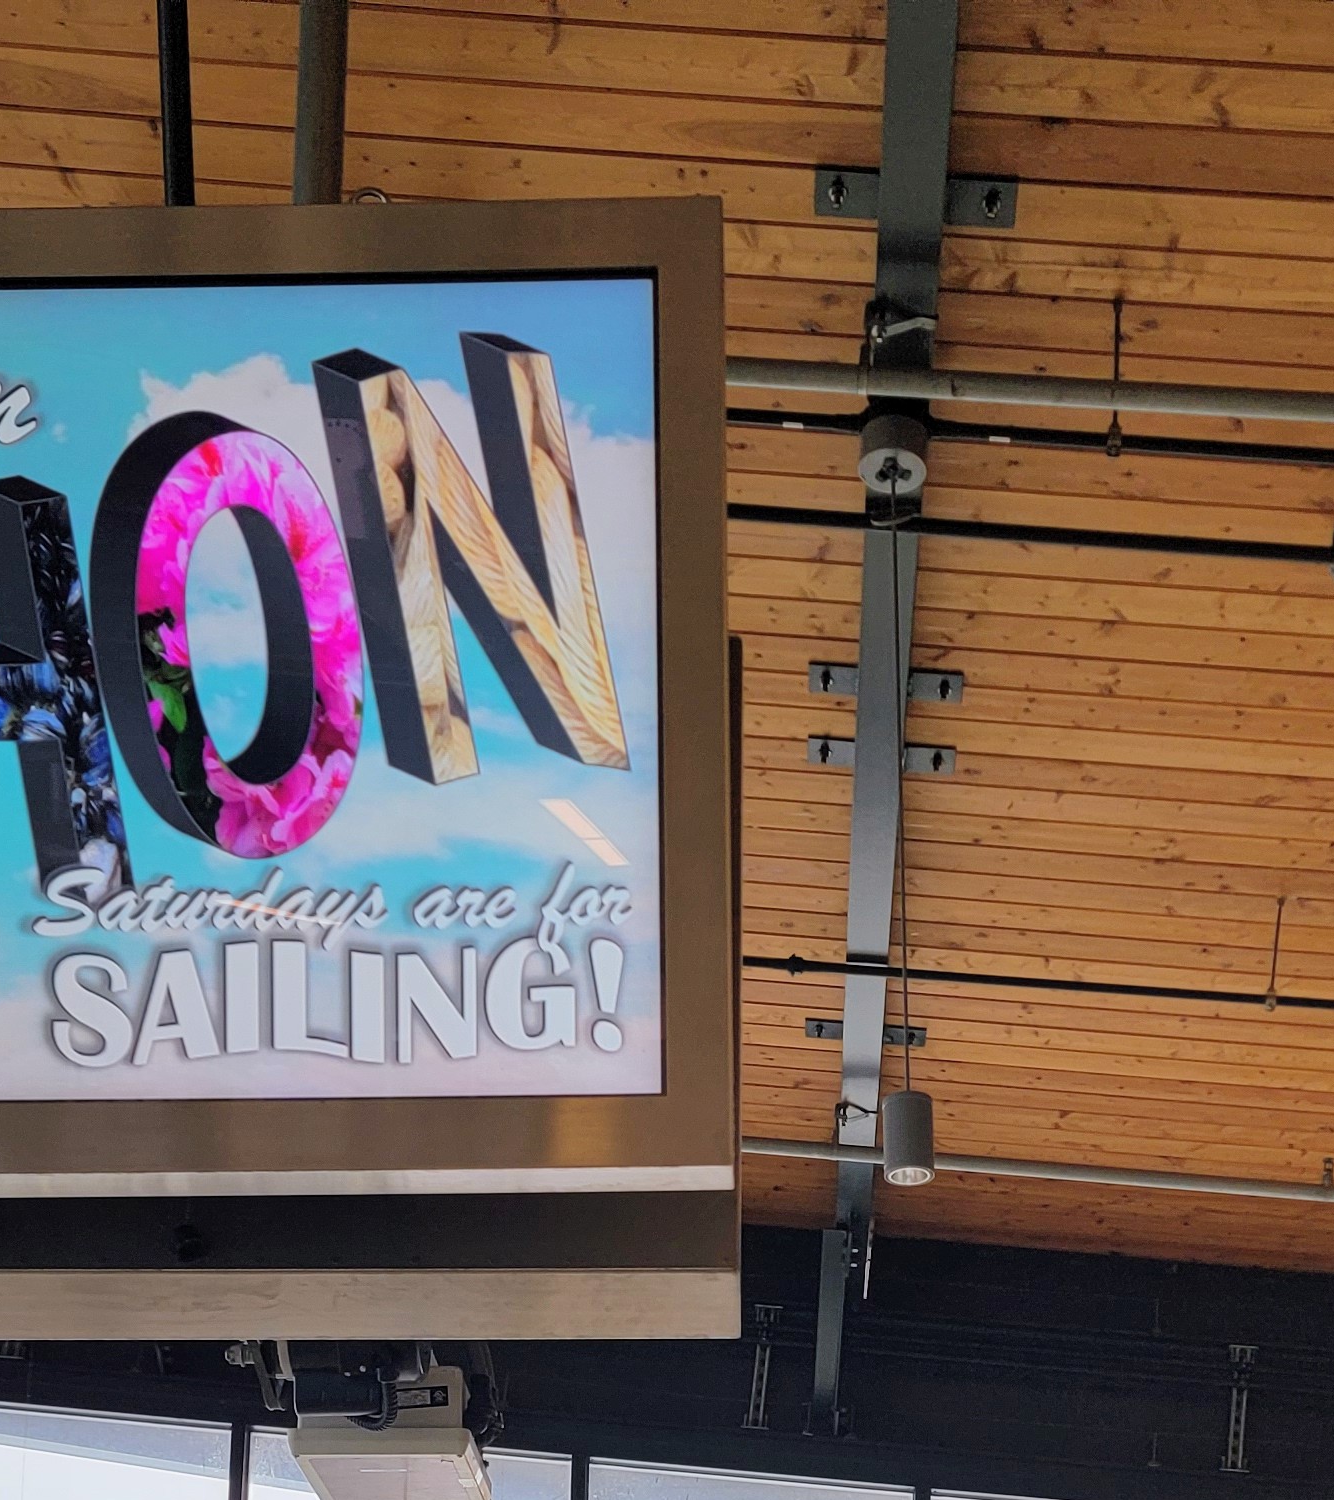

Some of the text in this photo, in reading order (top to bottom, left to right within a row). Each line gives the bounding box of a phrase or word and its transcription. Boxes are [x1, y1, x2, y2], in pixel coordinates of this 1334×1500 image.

[32, 860, 633, 976] Saturdays are for
[51, 935, 625, 1068] SAILING!
